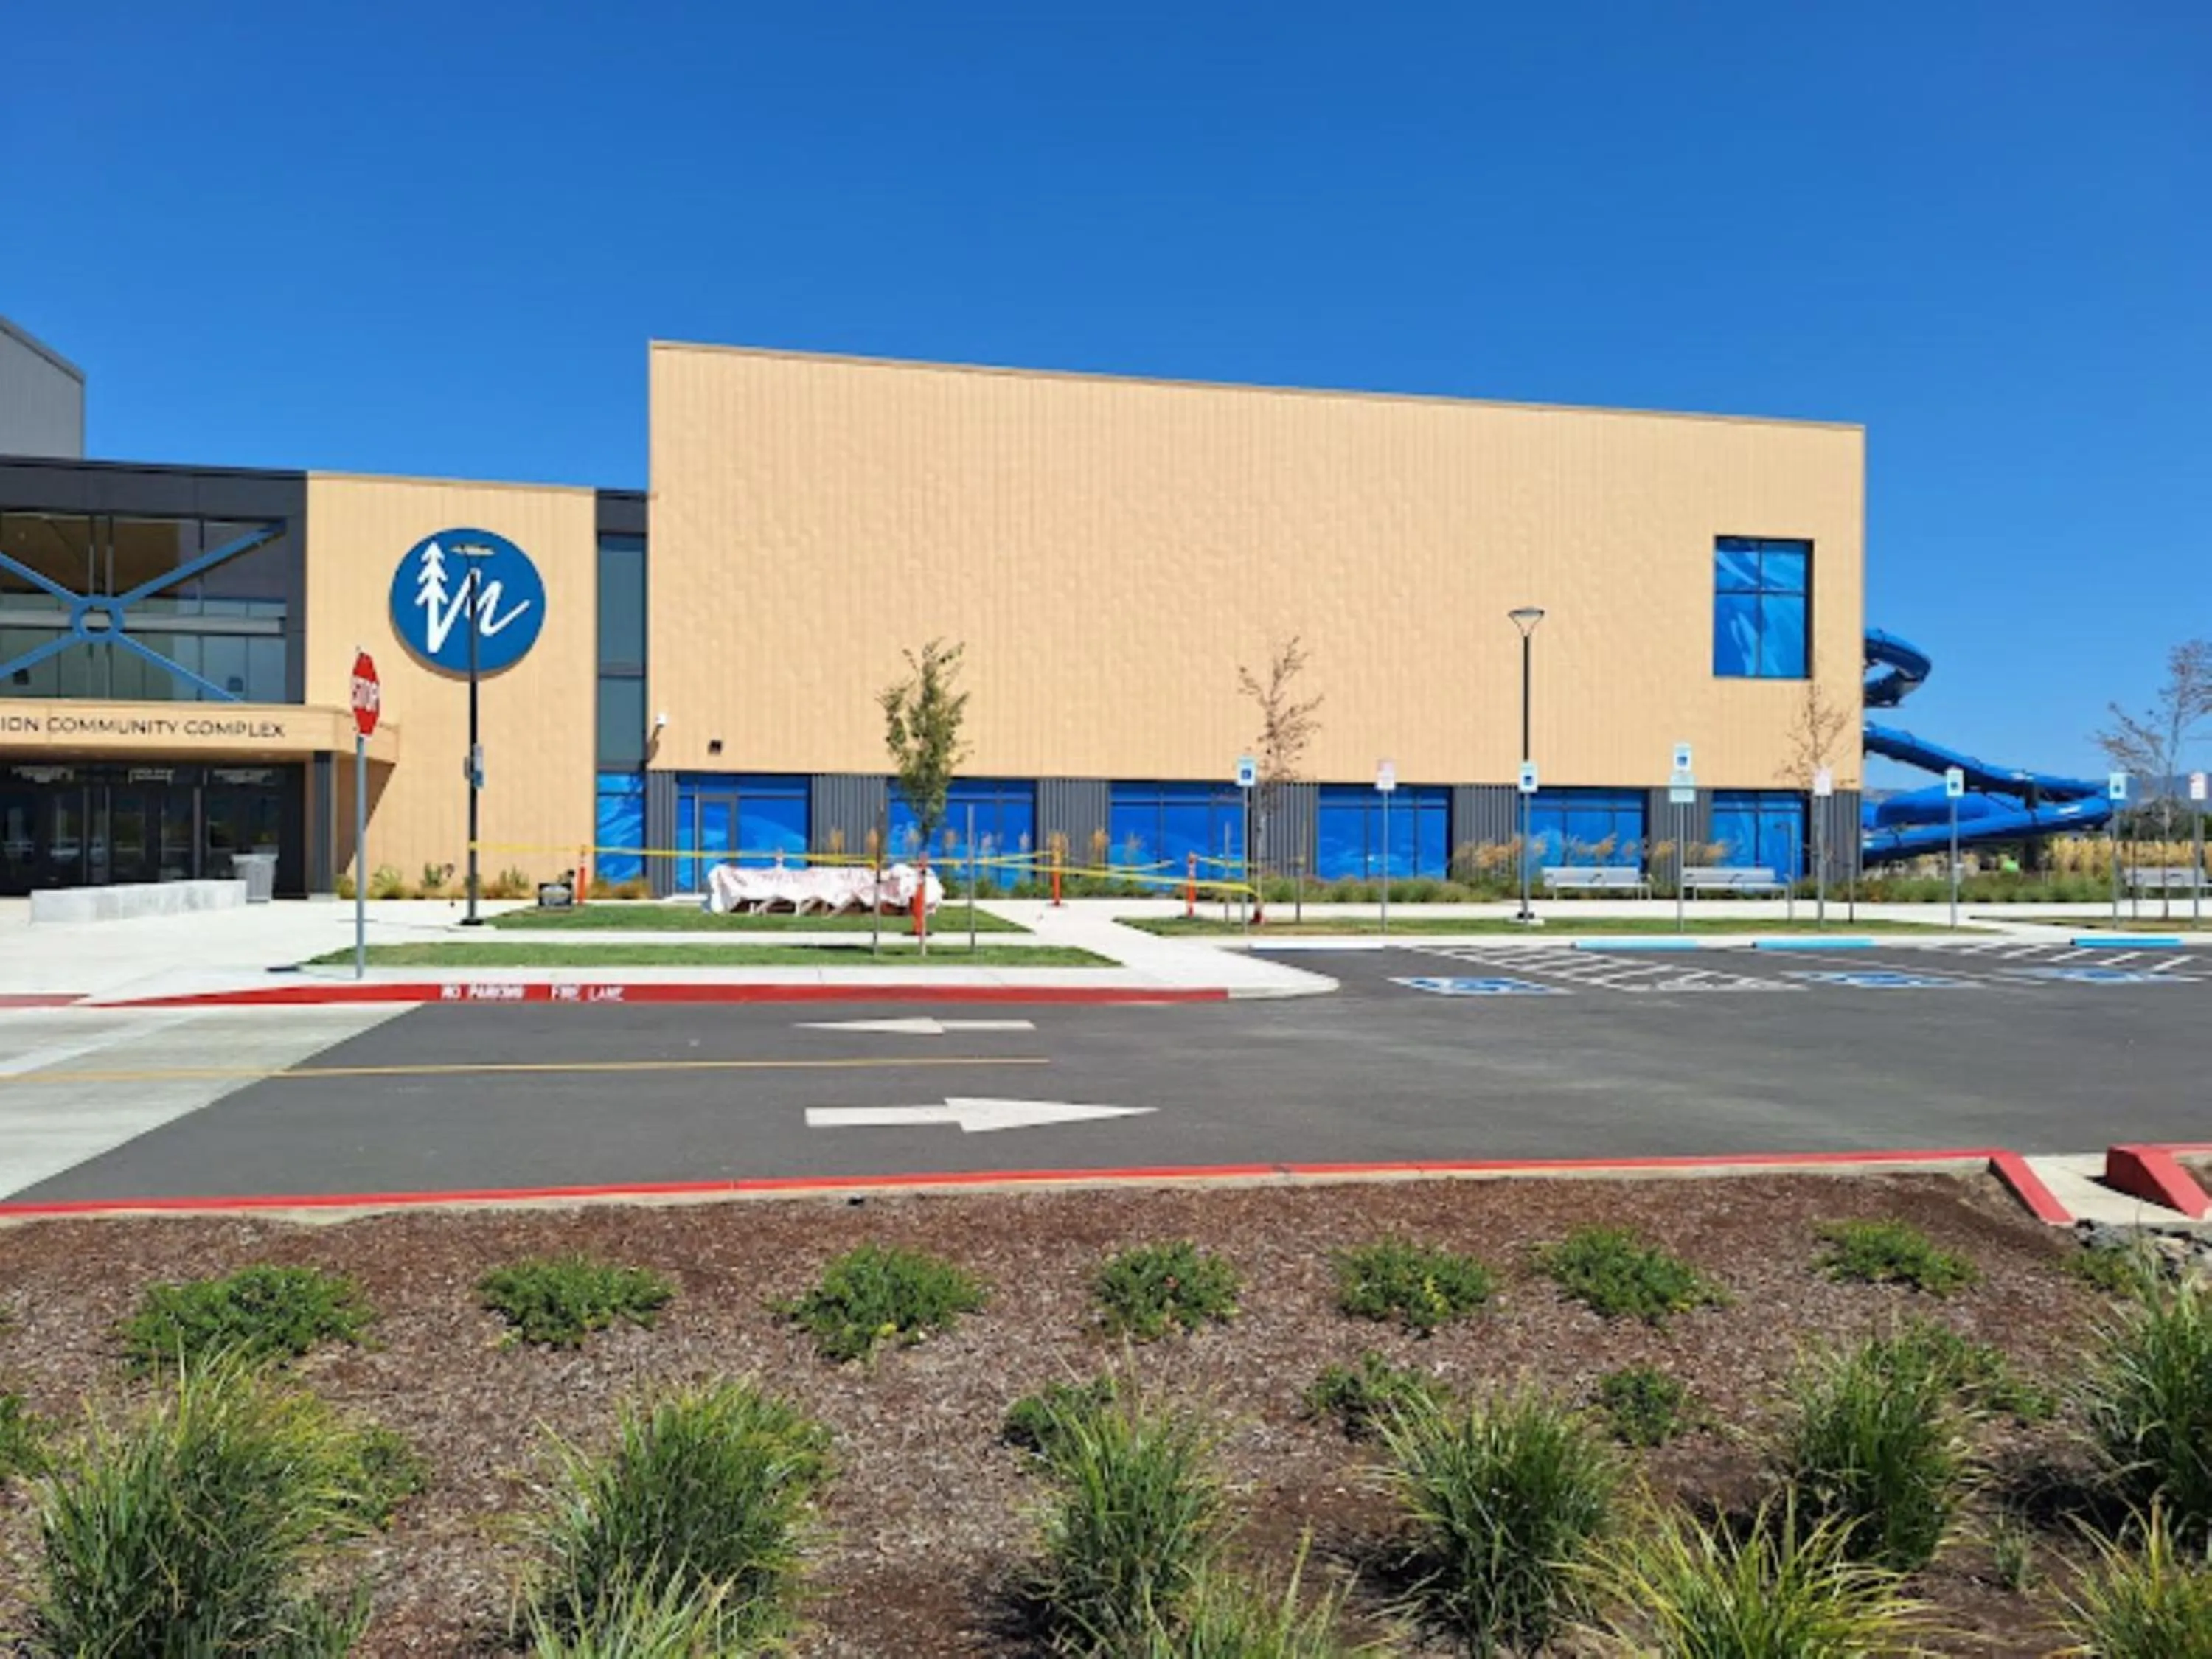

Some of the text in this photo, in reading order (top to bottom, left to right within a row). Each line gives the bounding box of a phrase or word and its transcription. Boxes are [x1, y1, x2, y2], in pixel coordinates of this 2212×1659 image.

[352, 675, 380, 711] STOP
[46, 717, 178, 735] COMMUNITY
[184, 720, 286, 737] COMPLEX
[589, 985, 625, 1001] LANE
